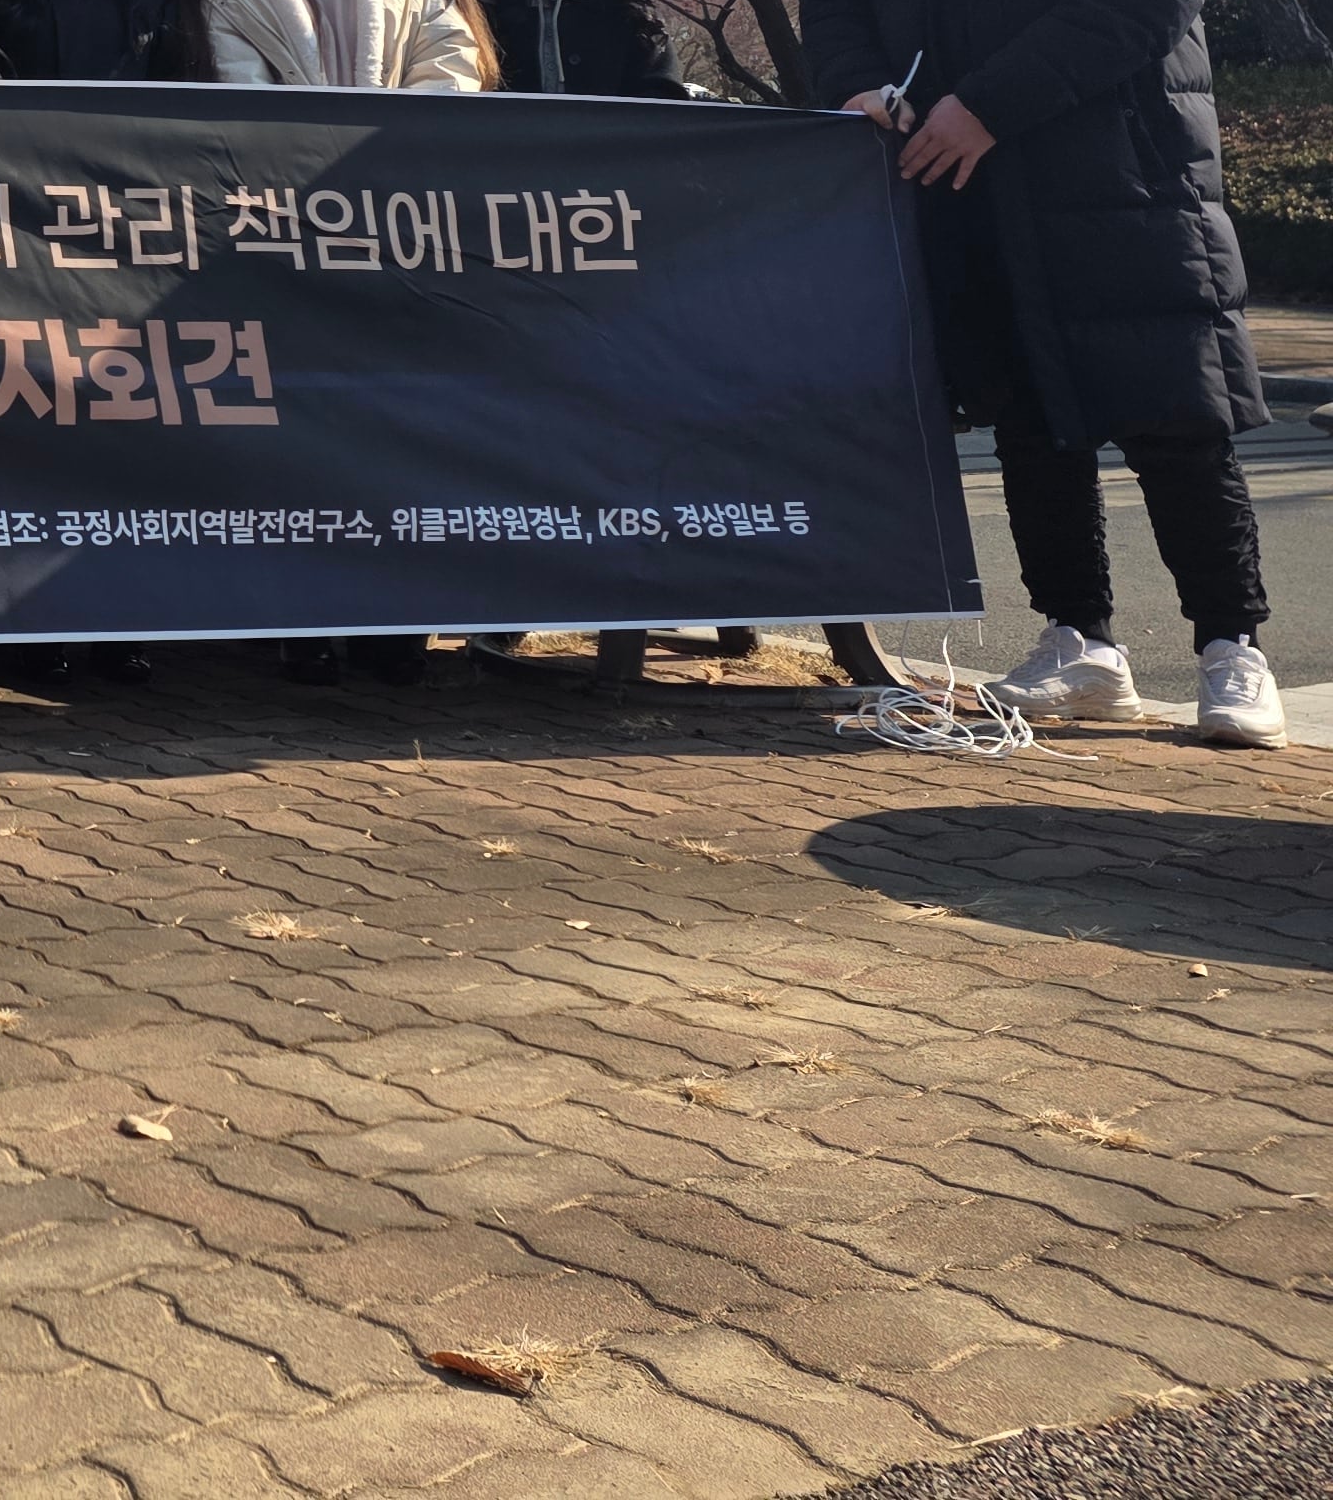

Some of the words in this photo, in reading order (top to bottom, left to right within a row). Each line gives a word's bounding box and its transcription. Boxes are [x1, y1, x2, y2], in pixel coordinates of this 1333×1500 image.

[44, 185, 198, 270] 관리
[228, 186, 464, 272] 책임에
[485, 189, 641, 273] 대한
[56, 509, 381, 546] 공정사회지역발전연구소,
[391, 506, 592, 544] 위클리창원경남,
[599, 508, 669, 542] KBS,
[673, 503, 780, 537] 경상일보
[784, 502, 809, 534] 등
